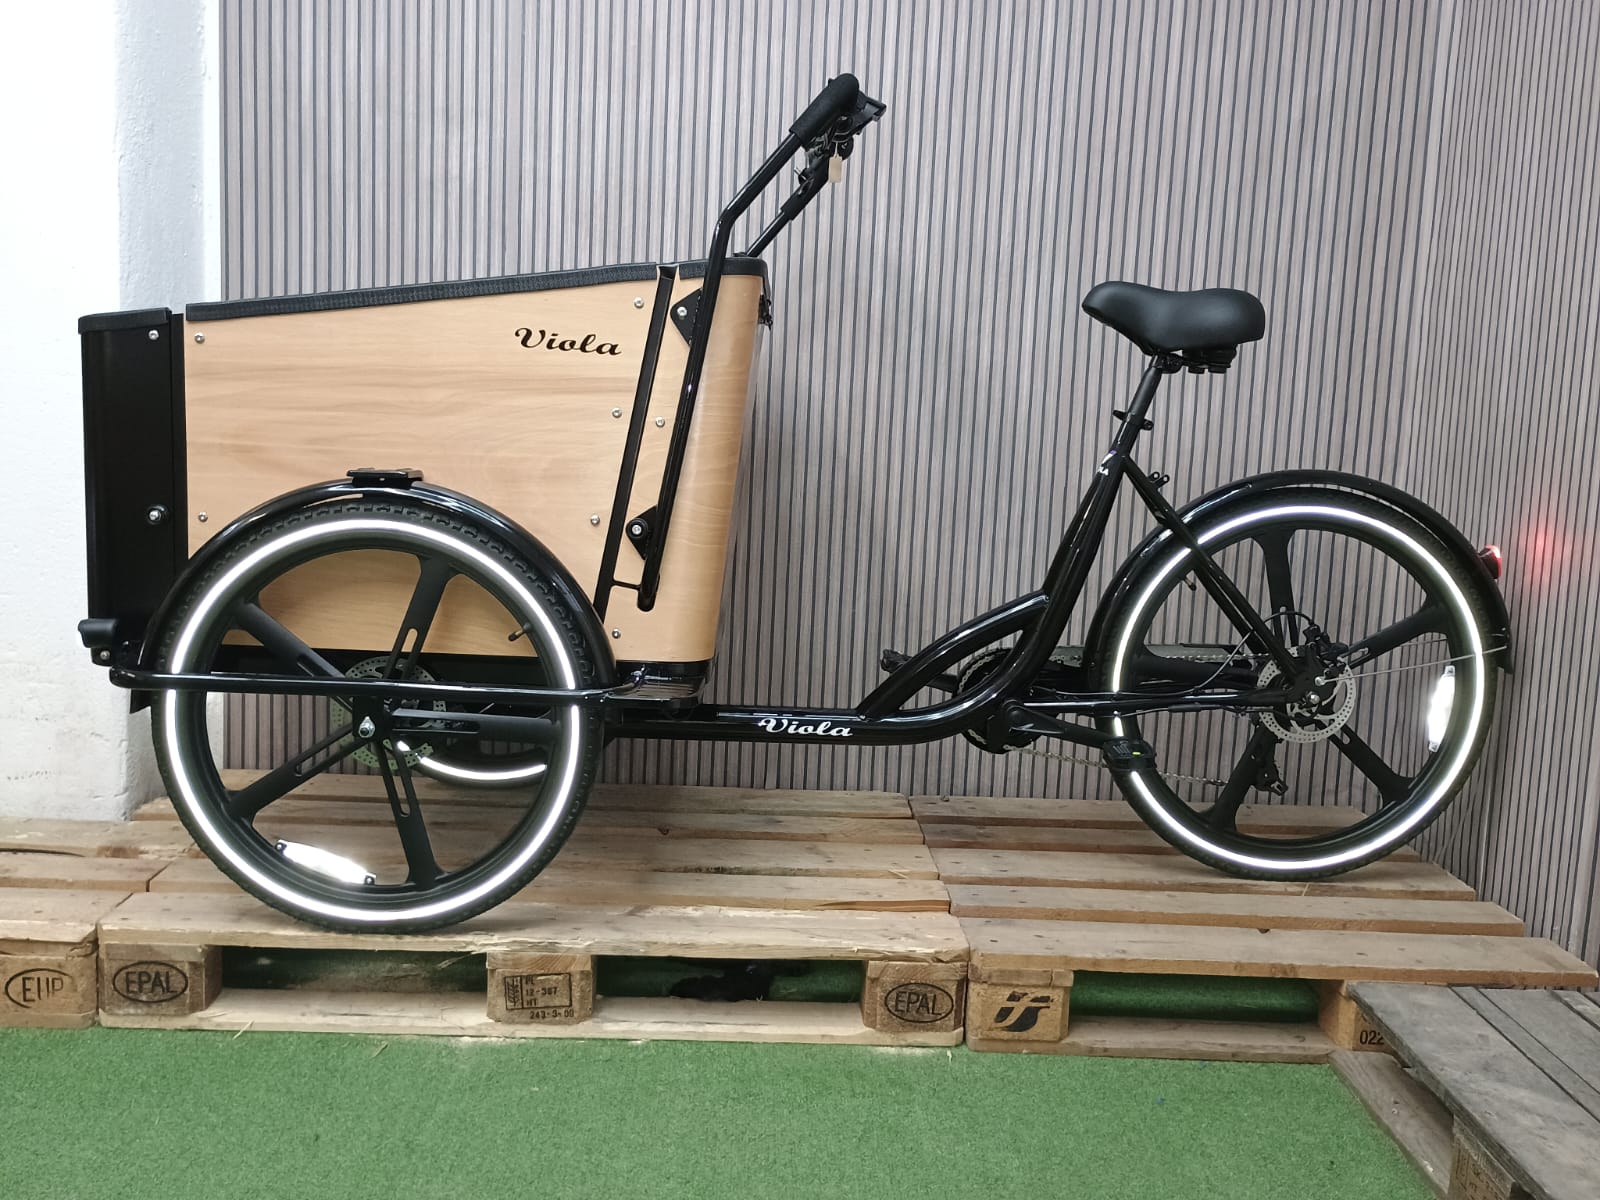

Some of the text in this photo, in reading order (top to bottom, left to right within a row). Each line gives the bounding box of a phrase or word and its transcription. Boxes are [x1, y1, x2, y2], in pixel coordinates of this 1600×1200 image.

[513, 327, 622, 356] Viola
[757, 717, 853, 737] Viola
[125, 970, 178, 994] EPAL
[894, 990, 942, 1016] EPAL
